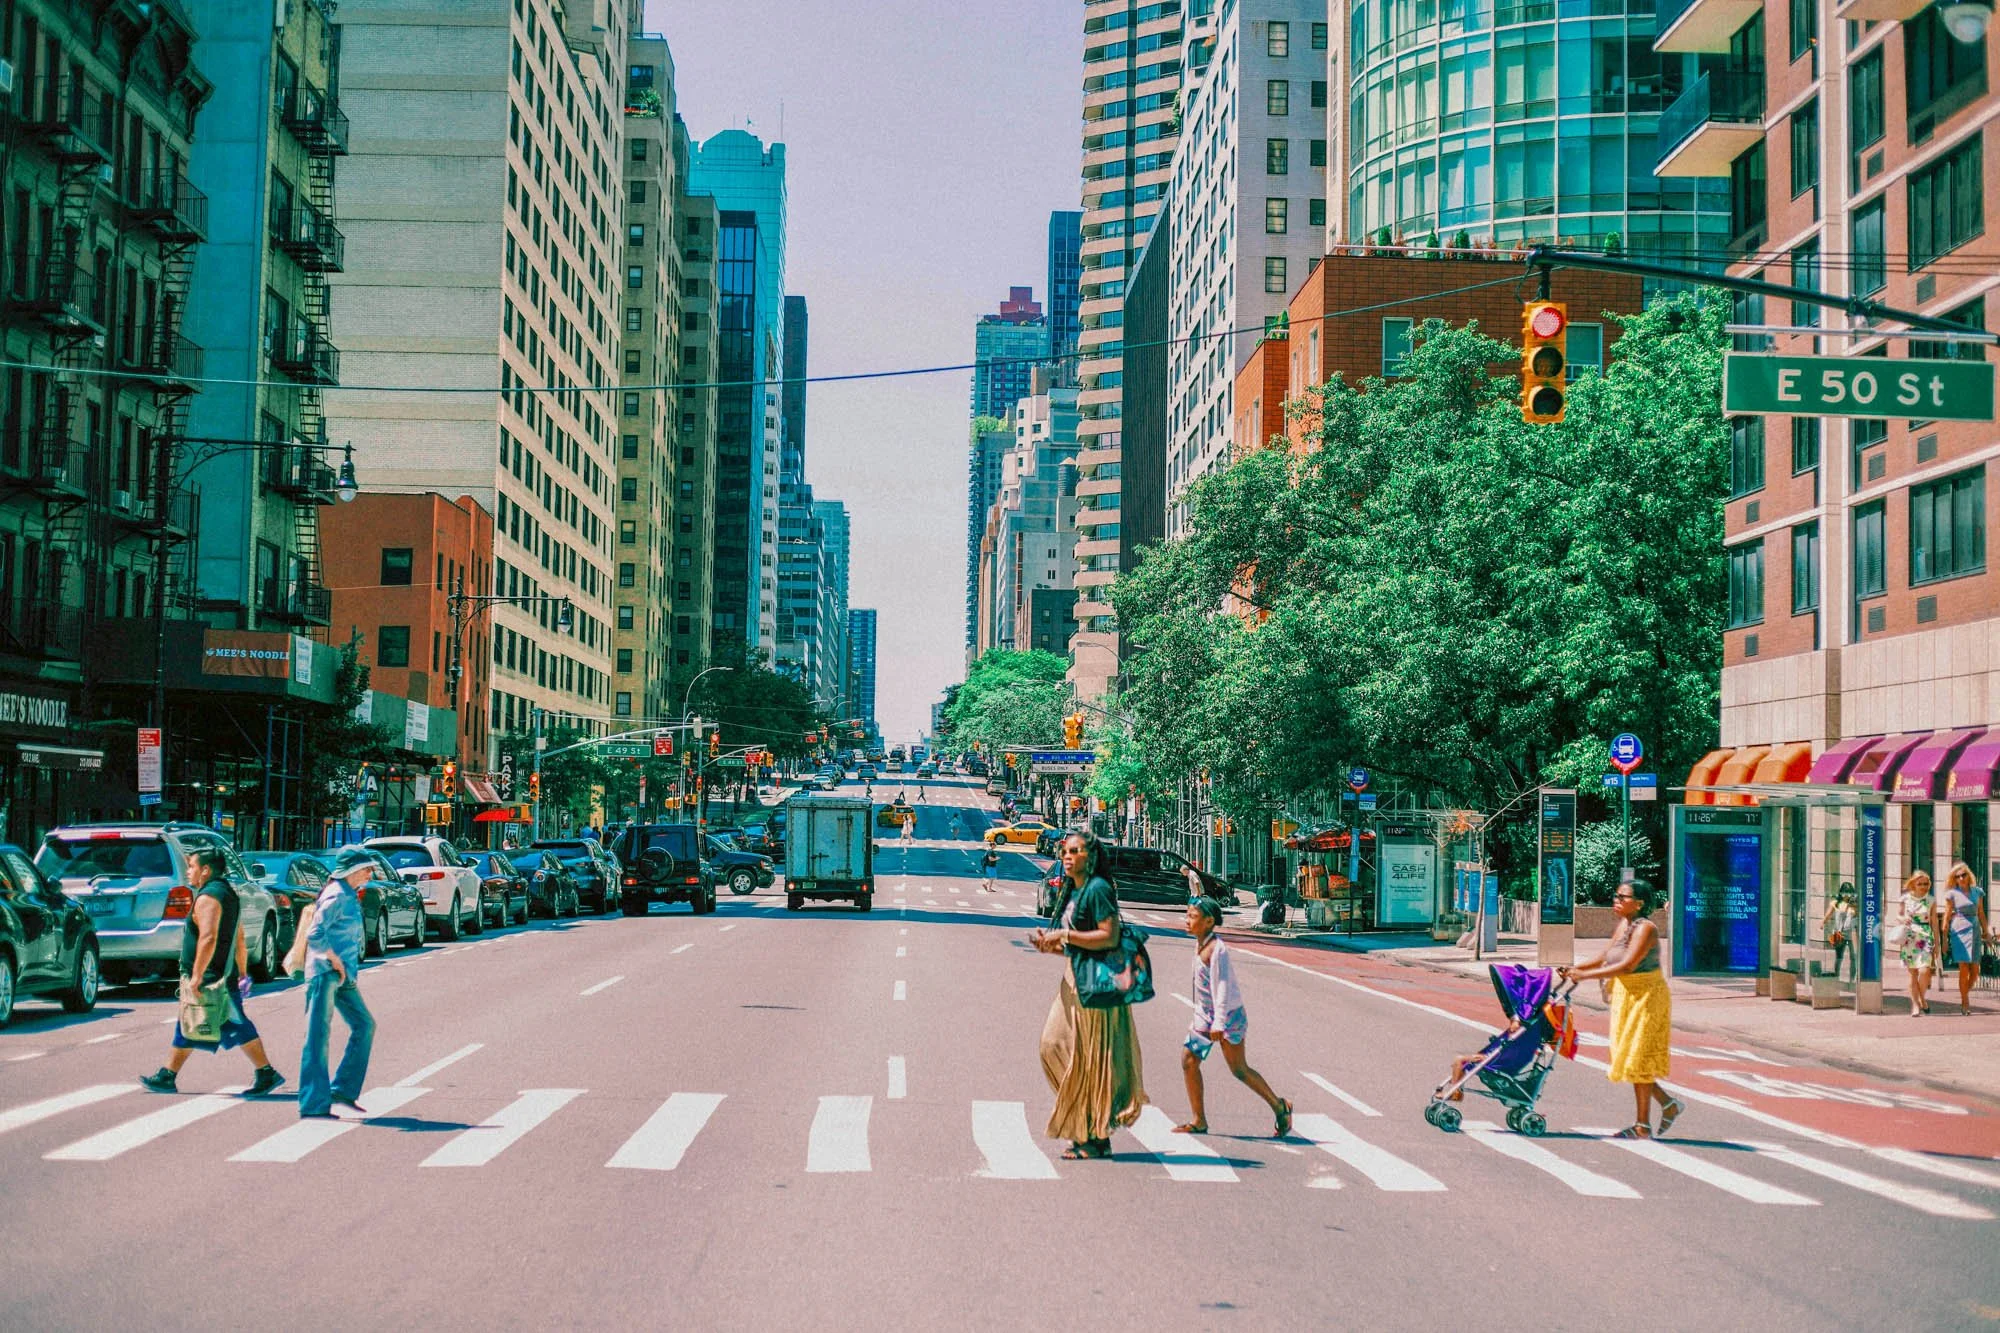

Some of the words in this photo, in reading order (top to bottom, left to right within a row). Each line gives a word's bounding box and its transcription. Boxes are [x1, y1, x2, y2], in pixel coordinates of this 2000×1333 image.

[1778, 369, 1801, 401] E
[1821, 370, 1878, 404] 50
[1896, 373, 1945, 406] St
[215, 648, 247, 658] MEE'S
[27, 696, 67, 728] NOODLE
[502, 755, 513, 791] PARK
[1689, 813, 1711, 822] 11:26
[1866, 829, 1876, 865] Avenue
[1391, 865, 1426, 873] CASH
[1866, 866, 1876, 874] &
[1866, 876, 1876, 898] East
[1866, 900, 1875, 912] 50
[1865, 914, 1875, 944] Street
